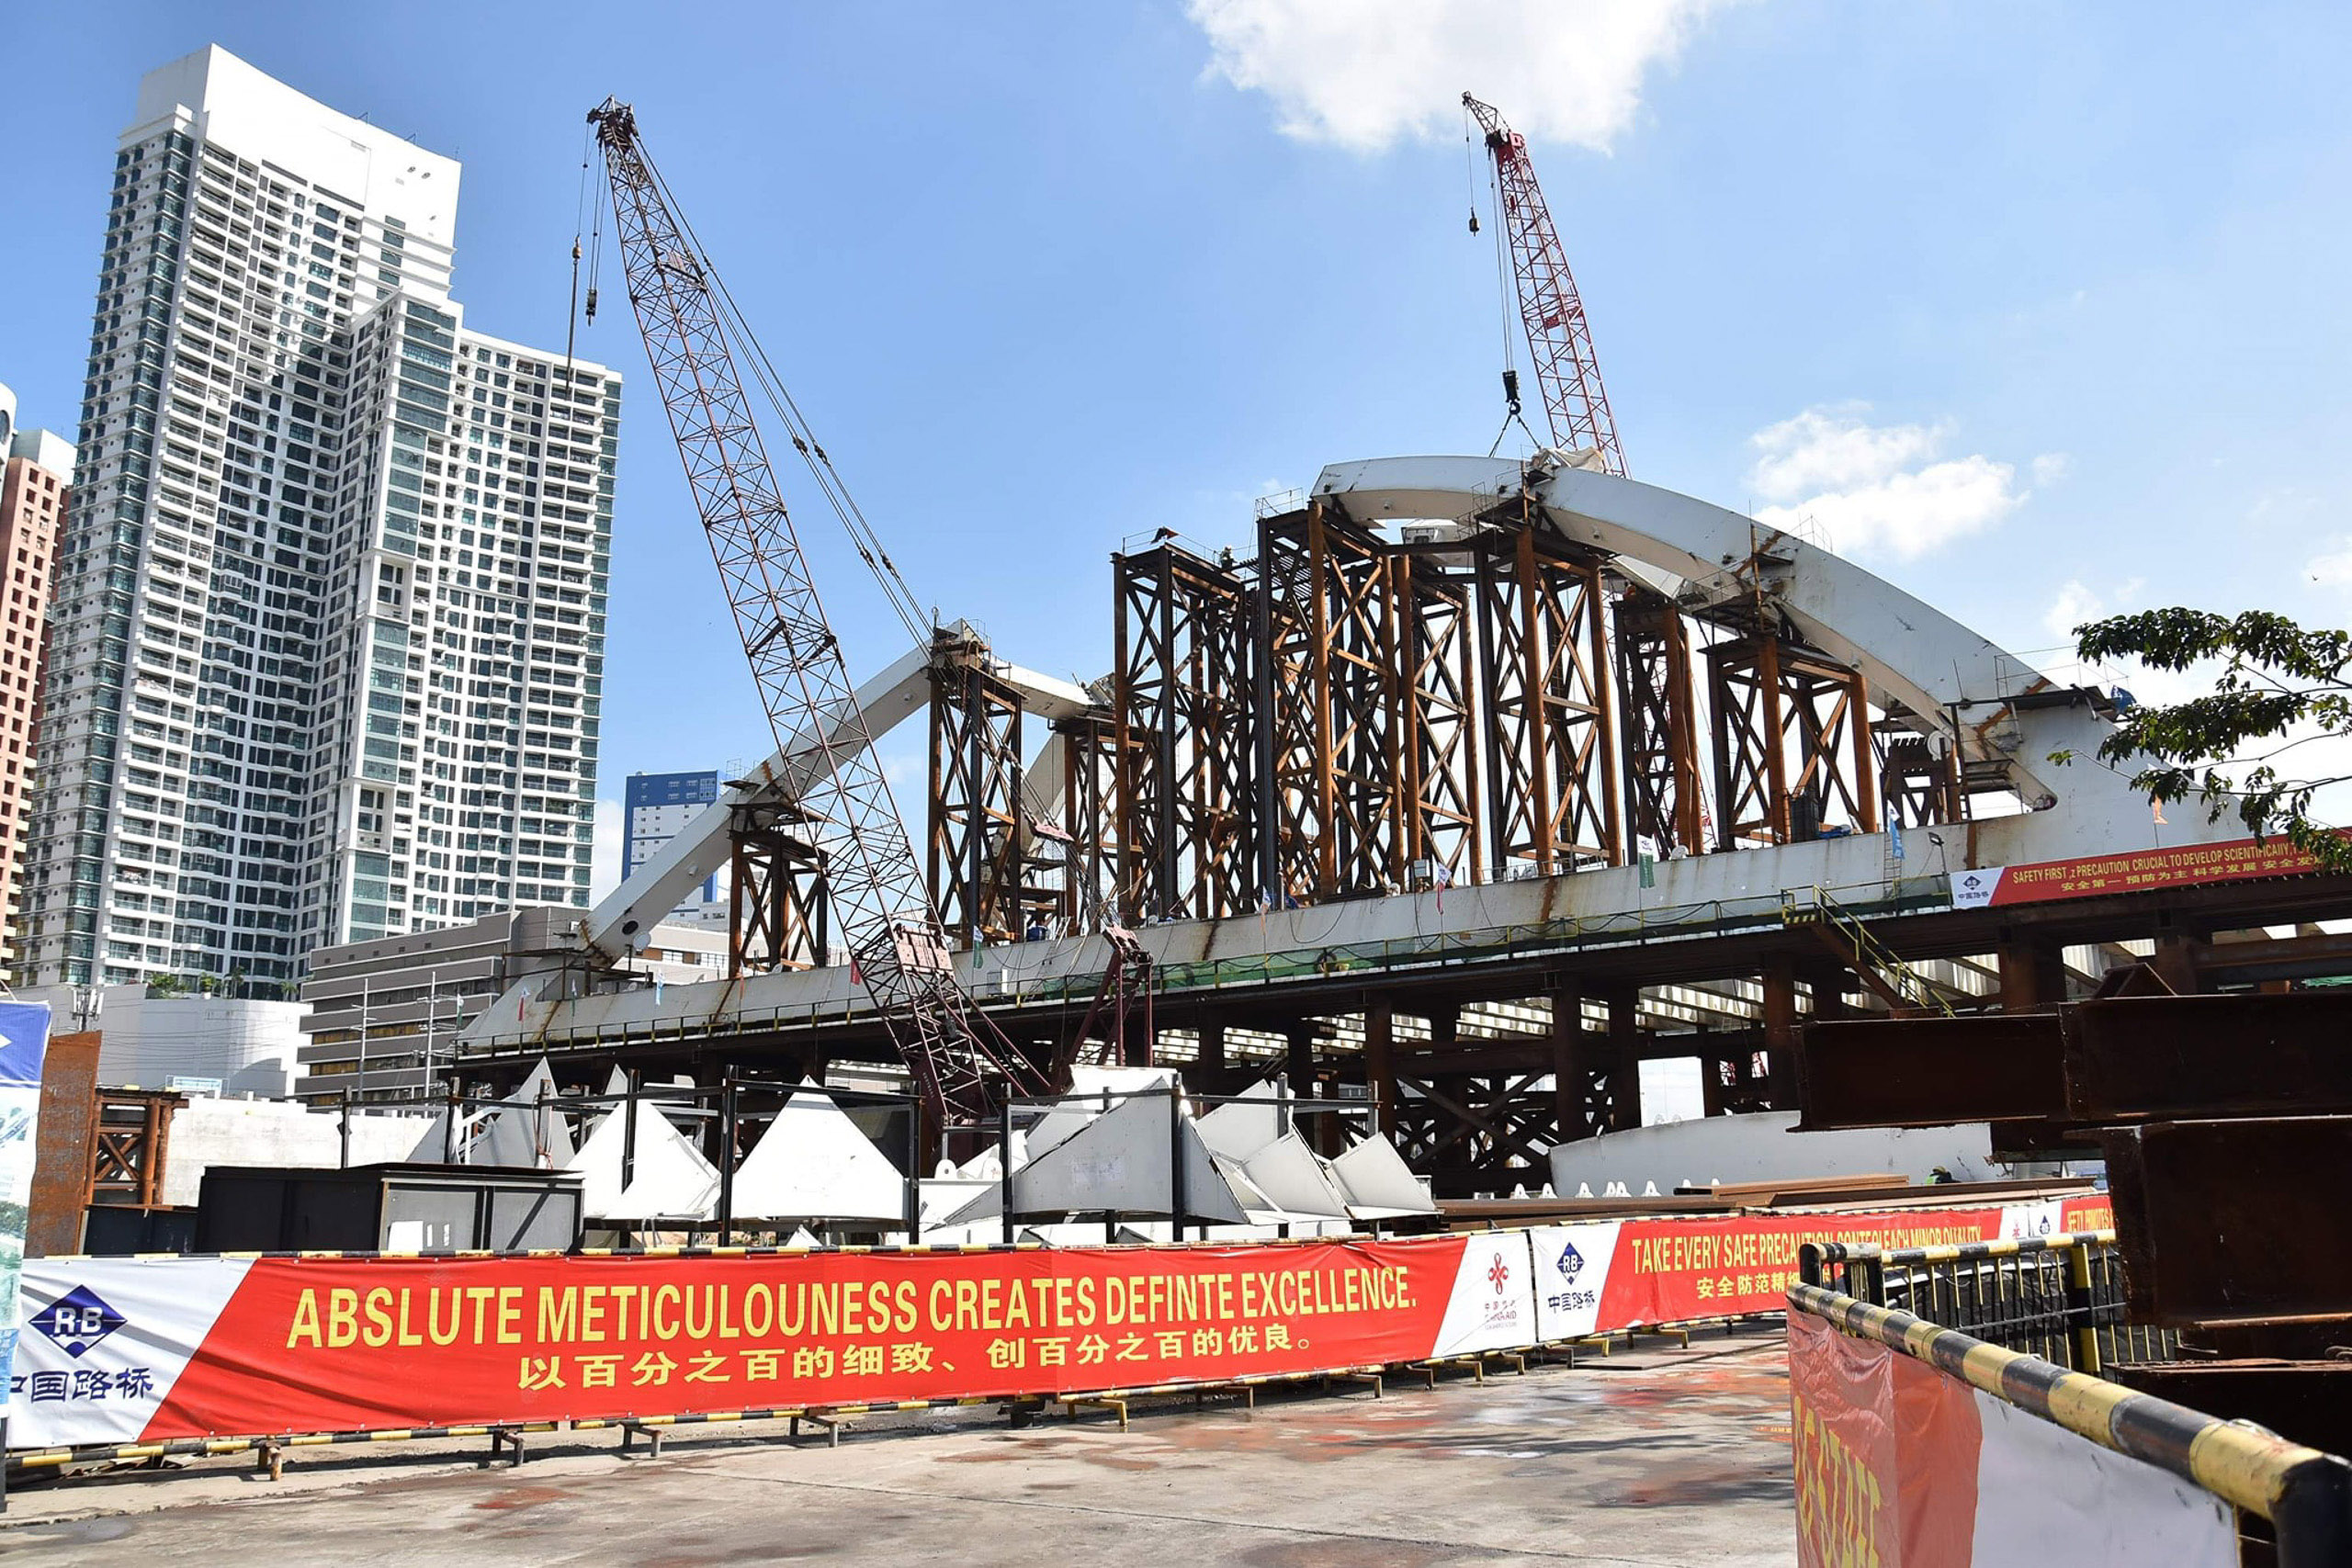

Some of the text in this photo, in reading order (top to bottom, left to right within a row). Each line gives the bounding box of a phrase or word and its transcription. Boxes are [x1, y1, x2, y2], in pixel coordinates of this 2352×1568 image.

[2012, 869, 2044, 885] SAFETY
[2044, 866, 2067, 881] FIRST
[2076, 861, 2130, 877] PRECAUTION
[2132, 855, 2169, 872] CRUCIAL
[2169, 853, 2182, 867] TO
[2183, 849, 2222, 865] DEVELOP
[1563, 1254, 1578, 1273] RB
[1632, 1238, 1671, 1274] TAKE
[1674, 1235, 1721, 1270] EVERY
[1723, 1234, 1757, 1269] SAFE
[287, 1267, 1417, 1348] ABSLUTE METICULOUNESS CREATES DEFINTE EXCELLENCE.
